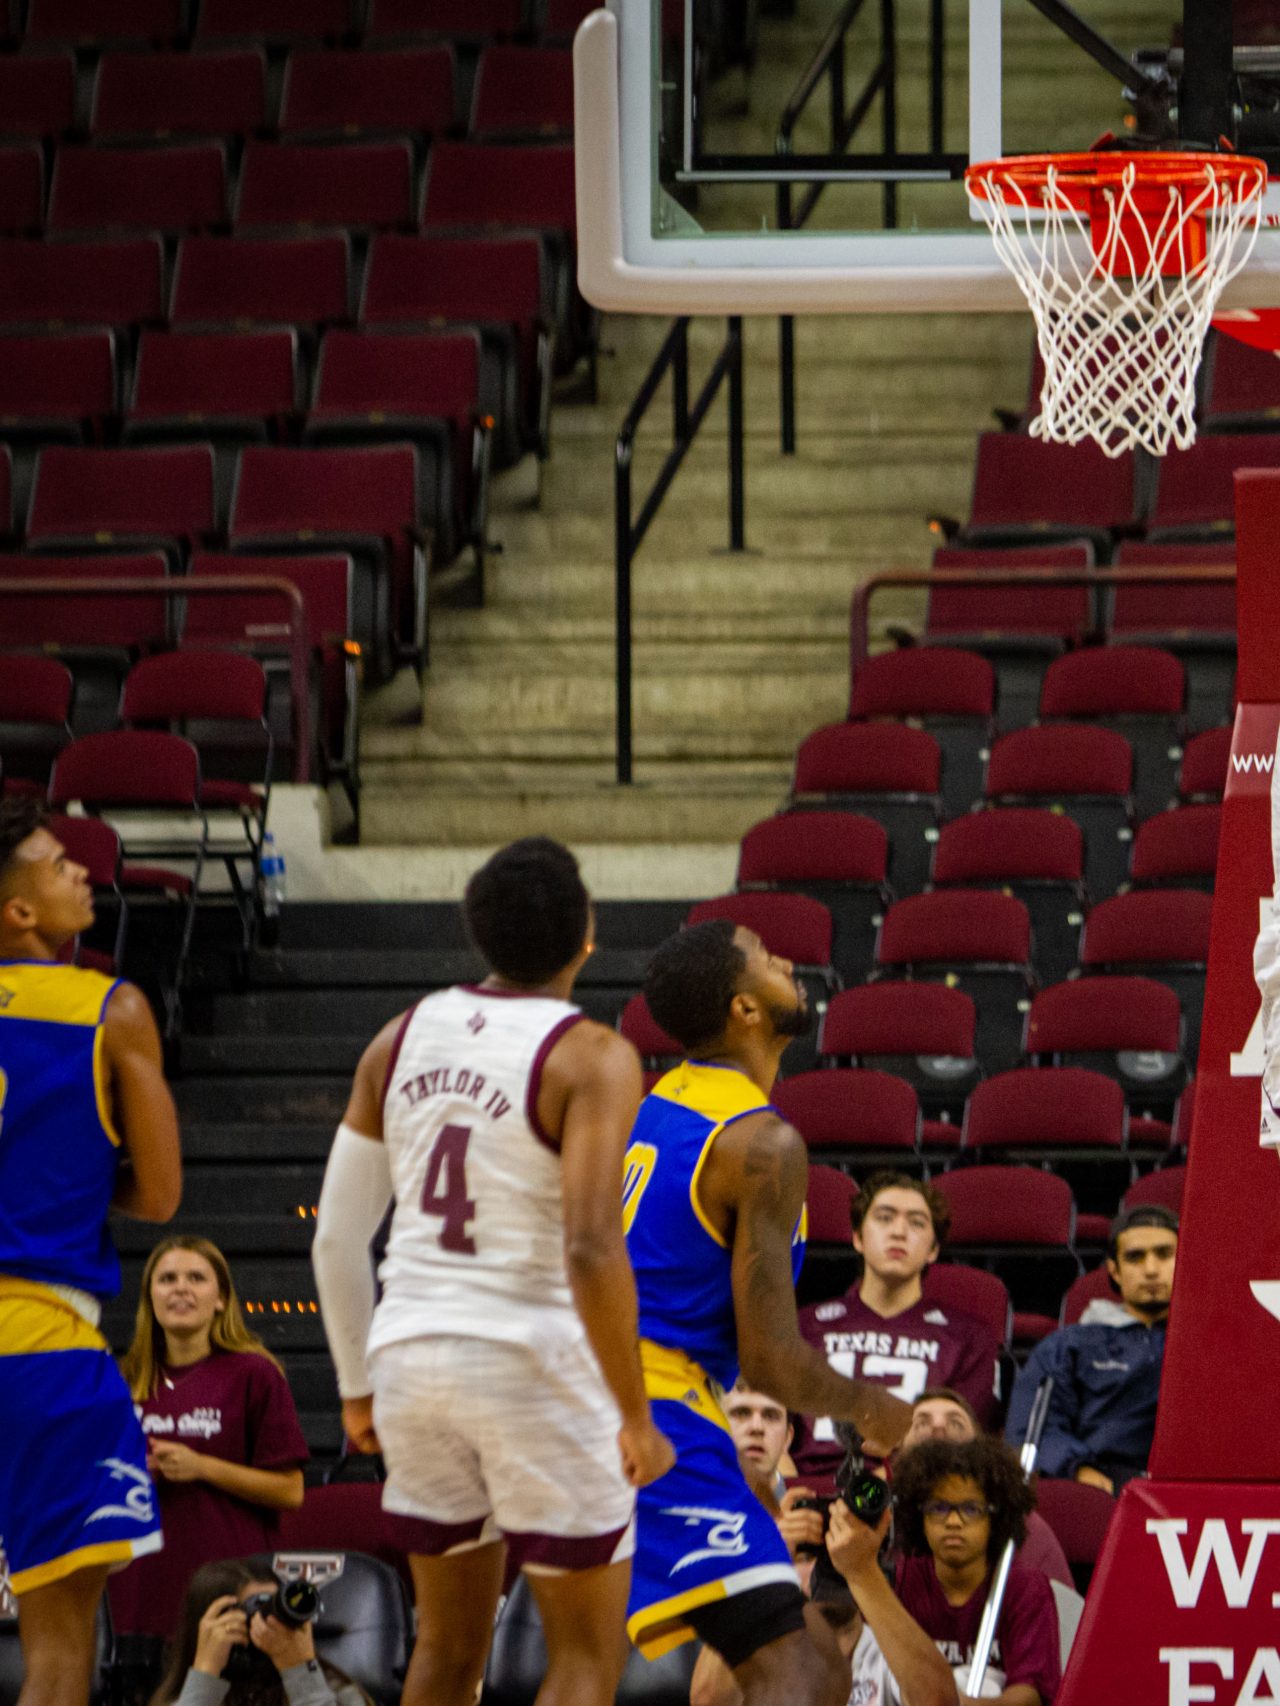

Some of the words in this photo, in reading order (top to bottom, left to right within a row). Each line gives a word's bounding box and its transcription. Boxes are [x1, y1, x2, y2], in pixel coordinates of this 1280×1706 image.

[400, 1068, 486, 1106] TAYLOR
[484, 1090, 512, 1121] IV
[421, 1123, 477, 1256] 4
[823, 1331, 893, 1356] TEXAS
[894, 1336, 940, 1362] A&M
